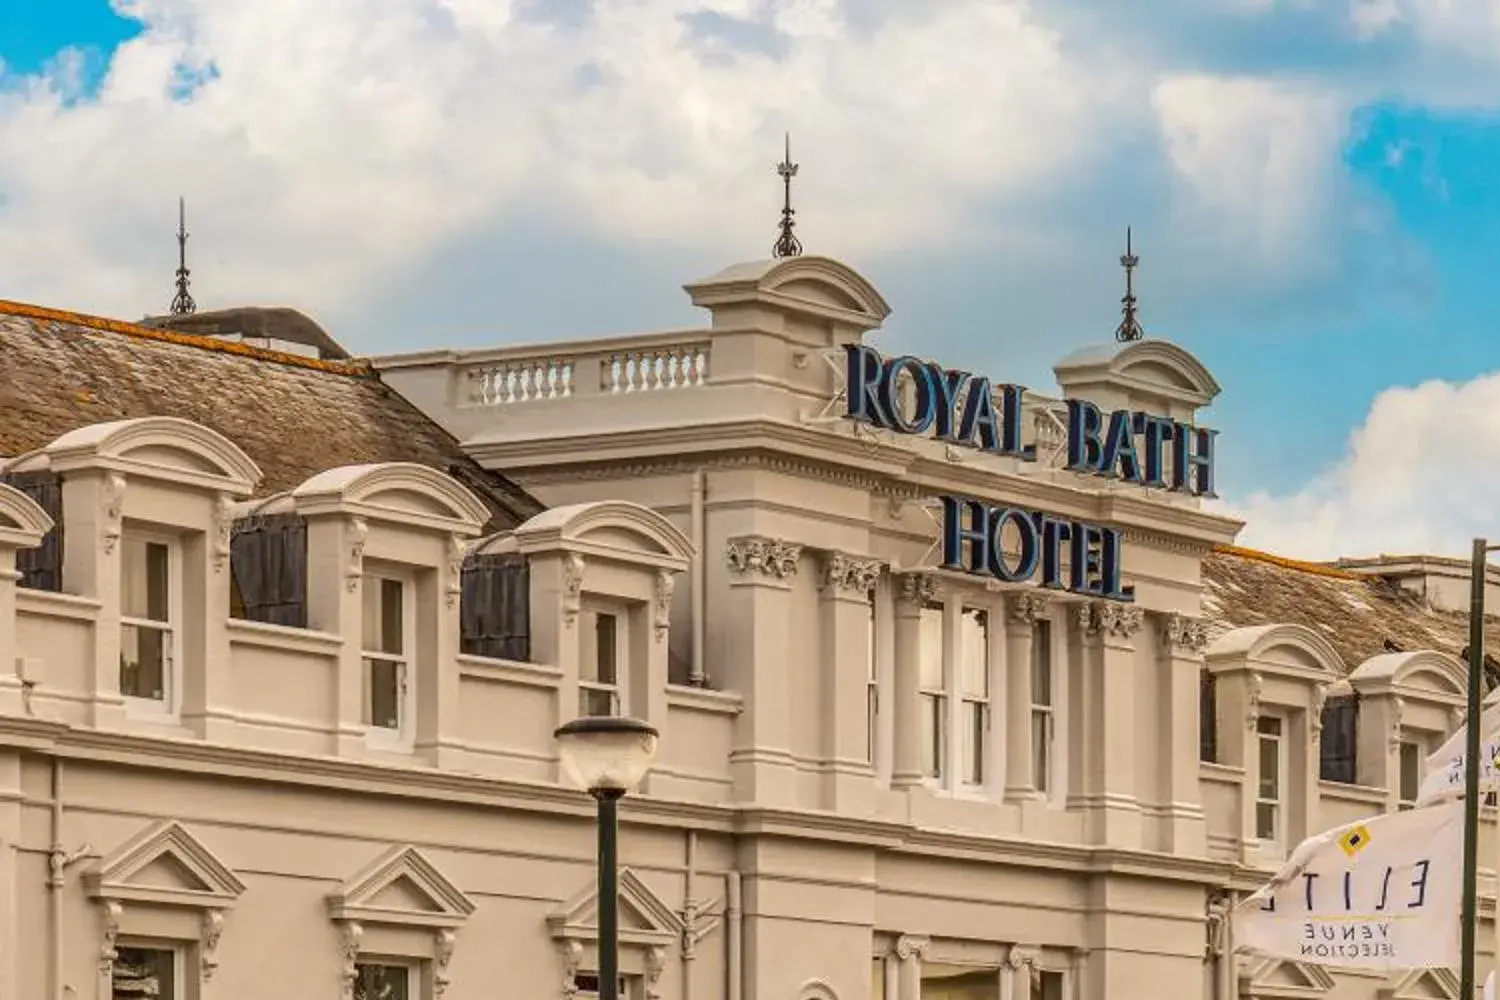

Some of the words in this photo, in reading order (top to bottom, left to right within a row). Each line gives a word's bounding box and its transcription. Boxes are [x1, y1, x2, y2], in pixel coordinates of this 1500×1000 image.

[842, 344, 1037, 462] ROYAL
[1064, 399, 1220, 499] BATH
[939, 496, 1134, 602] HOTEL
